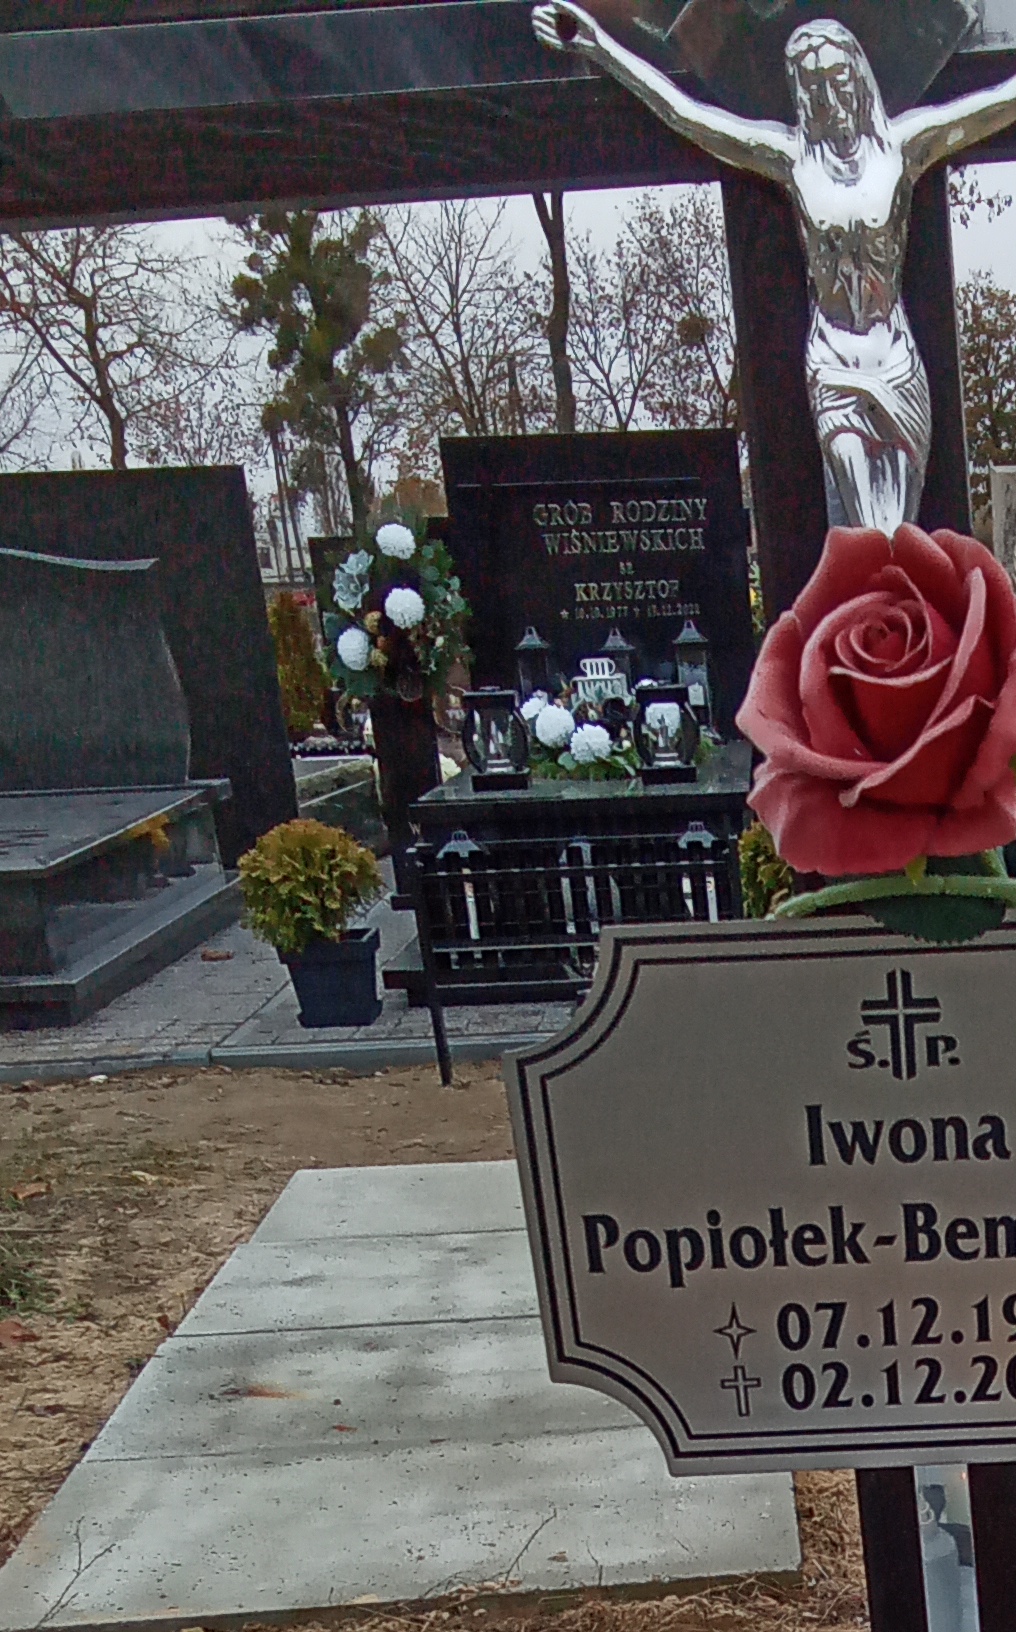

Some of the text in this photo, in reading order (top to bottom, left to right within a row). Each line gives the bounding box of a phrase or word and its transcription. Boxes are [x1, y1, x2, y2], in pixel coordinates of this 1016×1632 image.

[532, 498, 708, 526] GRÓB RODZINY
[541, 528, 706, 555] WIŚNIEWSKICH
[573, 579, 679, 602] KRZYSZTOF
[804, 1104, 1011, 1166] Iwona
